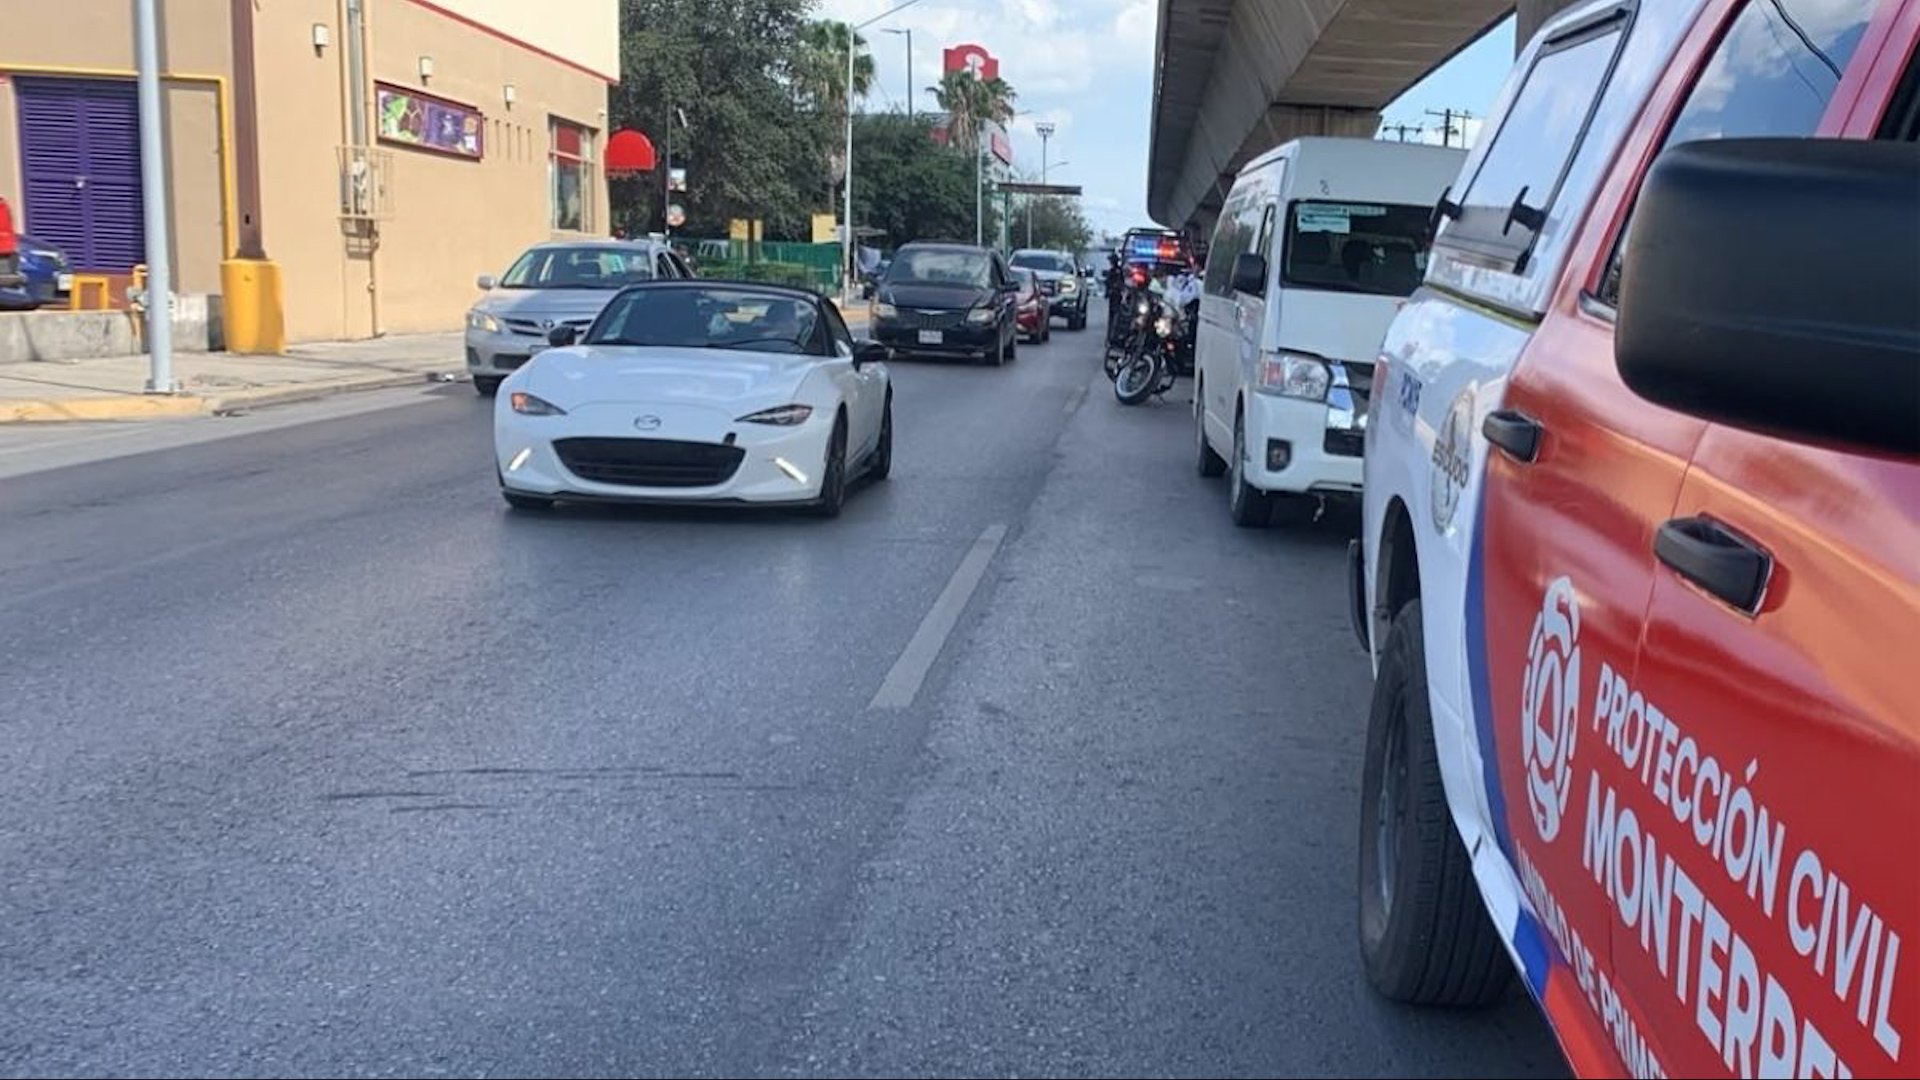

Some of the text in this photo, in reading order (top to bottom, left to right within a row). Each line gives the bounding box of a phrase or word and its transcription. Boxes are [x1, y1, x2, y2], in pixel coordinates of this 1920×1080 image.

[1571, 926, 1601, 1014] DE
[1582, 769, 1854, 1079] MONTERR
[1593, 662, 1901, 1063] PROTECCIÓN CIVIL
